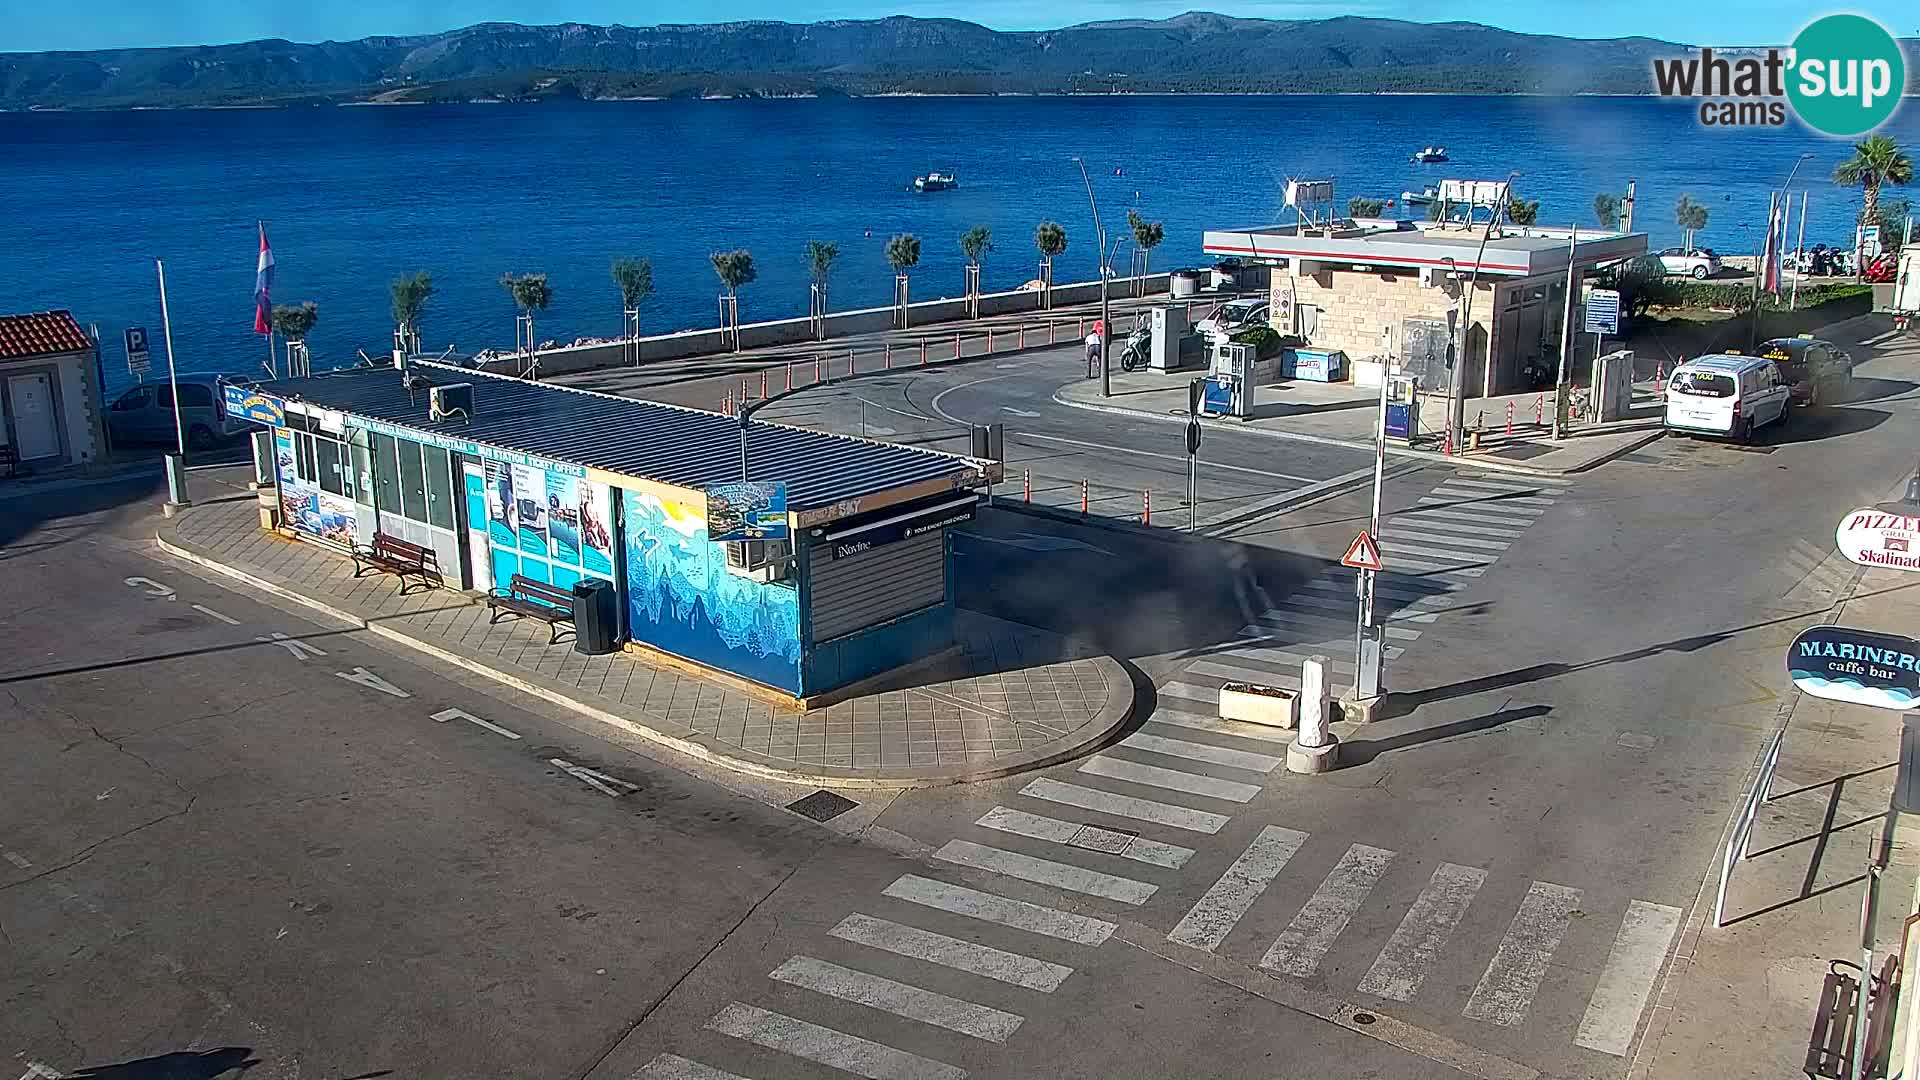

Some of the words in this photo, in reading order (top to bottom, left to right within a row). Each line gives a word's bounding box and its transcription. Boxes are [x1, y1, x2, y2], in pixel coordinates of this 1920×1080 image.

[130, 331, 142, 349] P
[1696, 373, 1714, 381] TAXI
[477, 445, 493, 458] BUS
[494, 450, 526, 465] STATION
[528, 456, 554, 471] TICKET
[555, 461, 583, 477] OFFICE
[952, 513, 971, 523] CHOICE
[1848, 515, 1920, 532] PIZZE
[1828, 661, 1865, 675] caffe
[1869, 665, 1896, 679] bar
